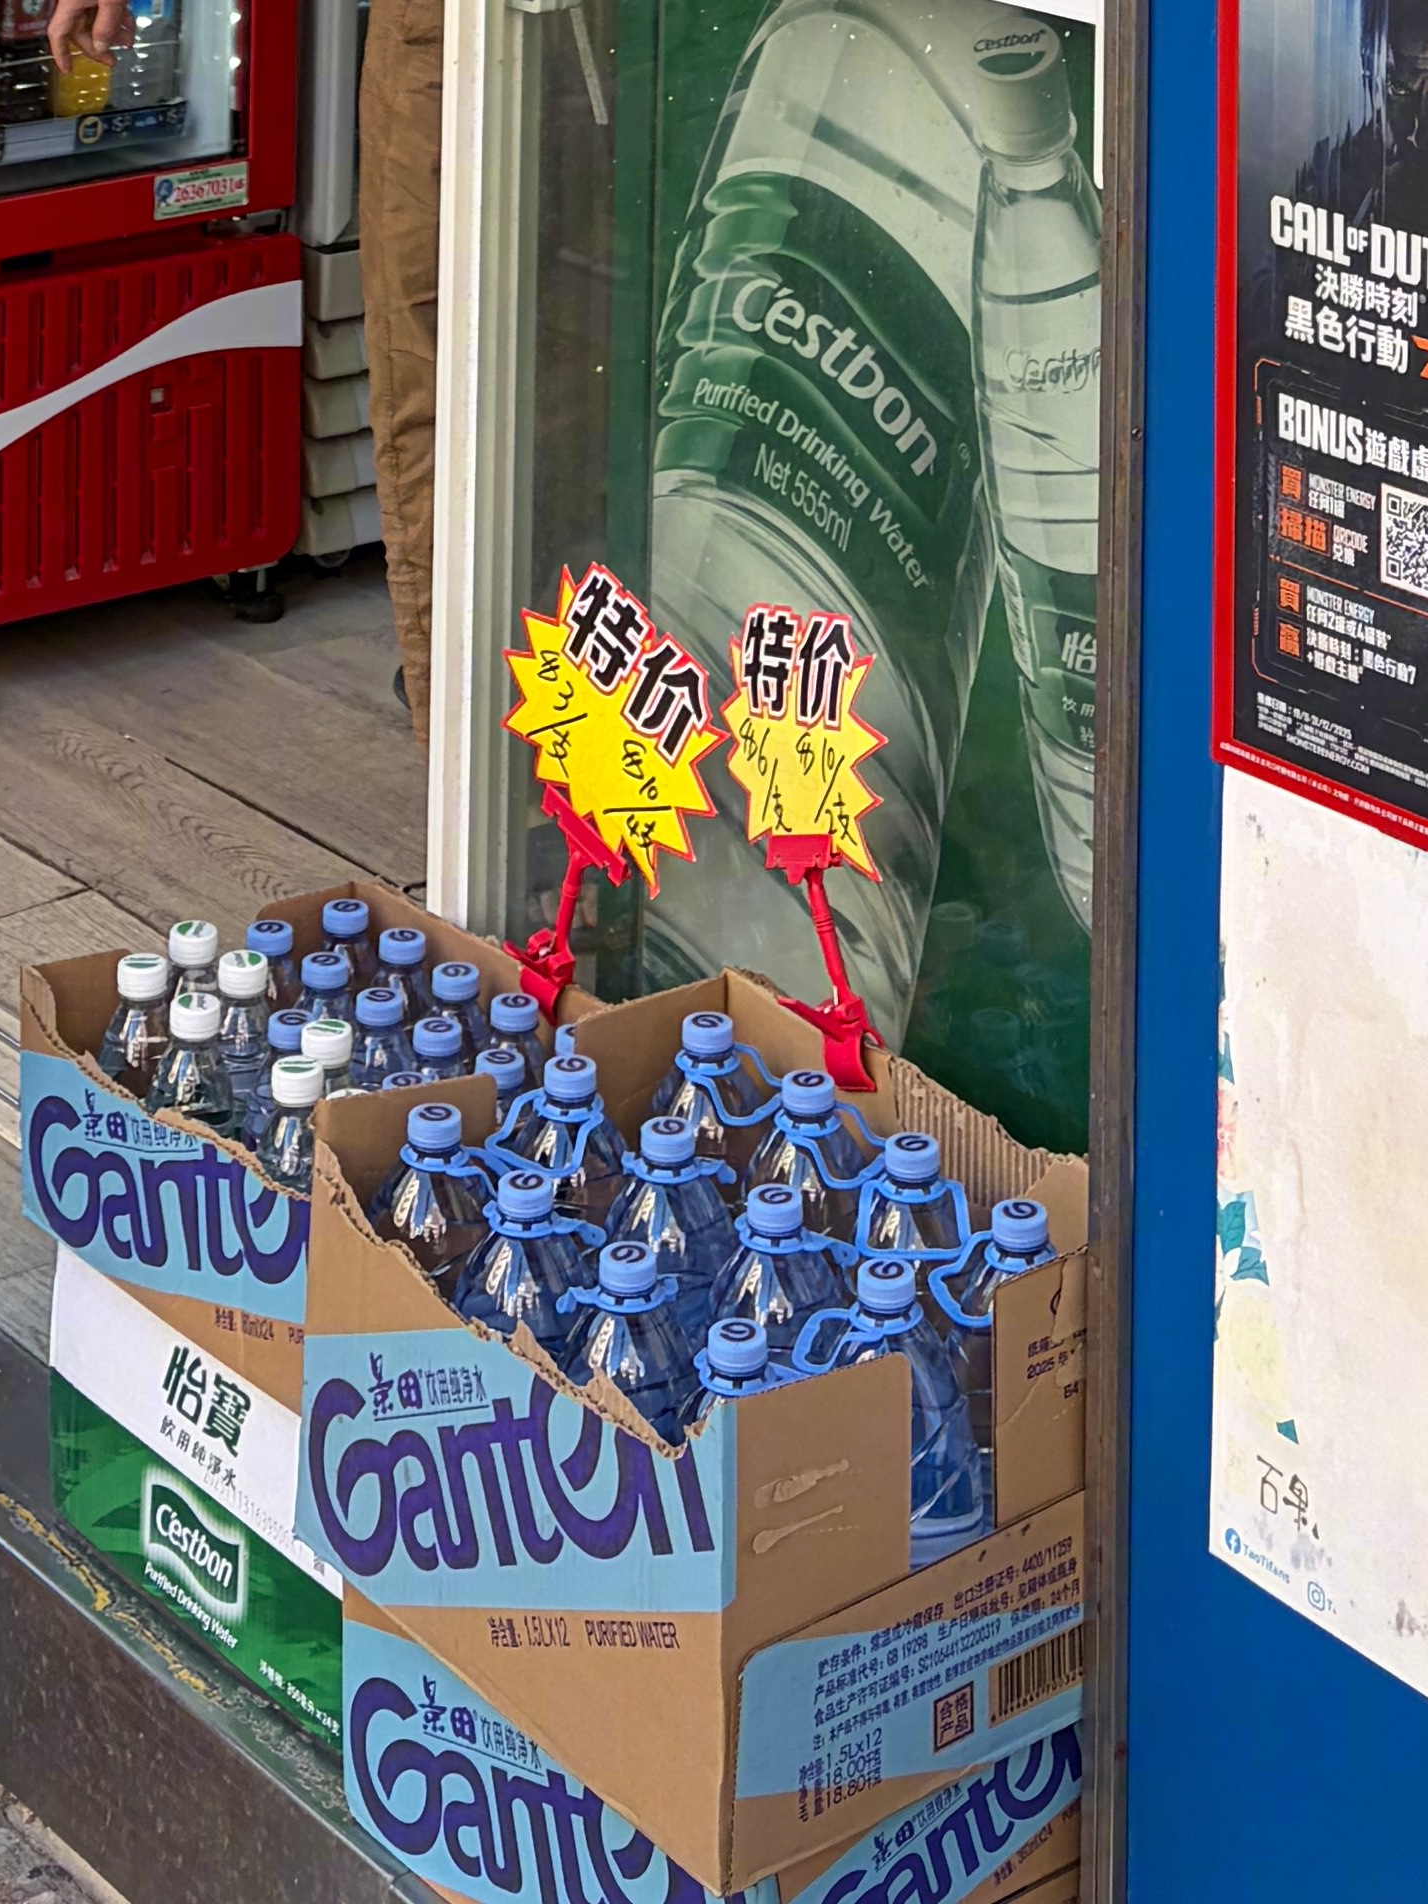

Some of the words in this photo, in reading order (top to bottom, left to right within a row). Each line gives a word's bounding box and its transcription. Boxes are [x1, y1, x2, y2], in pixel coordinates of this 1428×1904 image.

[1270, 194, 1346, 268] CALL
[1347, 225, 1370, 254] OF
[1314, 263, 1420, 329] 決勝時刻
[692, 376, 774, 425] Purified
[775, 412, 870, 510] Drinking
[868, 505, 931, 590] Water
[753, 442, 790, 496] Net
[787, 481, 854, 553] 555ml
[568, 576, 705, 759] 特价
[742, 607, 852, 726] 特价
[28, 1094, 310, 1287] Gante
[162, 1344, 252, 1460] 怡寶
[144, 1561, 178, 1597] Purified
[176, 1585, 213, 1626] Drinking
[209, 1614, 240, 1651] Water
[583, 1619, 636, 1649] PURIFIED
[636, 1621, 681, 1650] WATER
